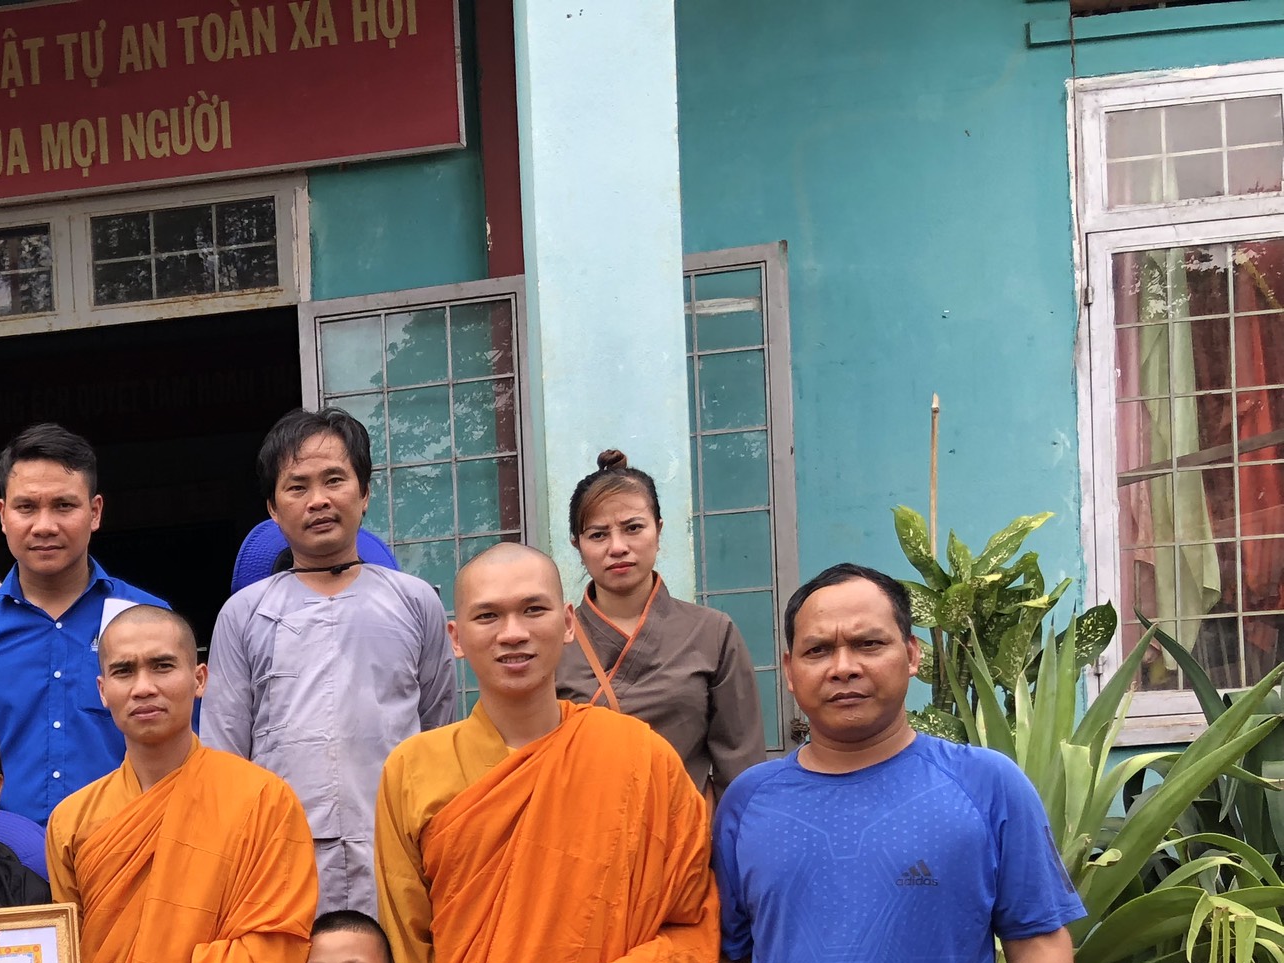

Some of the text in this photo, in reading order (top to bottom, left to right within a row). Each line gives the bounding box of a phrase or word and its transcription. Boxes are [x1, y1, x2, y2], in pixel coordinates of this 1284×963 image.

[62, 19, 107, 88] TỰ
[118, 20, 168, 74] AN
[176, 0, 277, 65] TOÀN
[41, 118, 110, 178] MỌI
[121, 90, 232, 161] NGƯỜI
[896, 875, 939, 887] adidas
